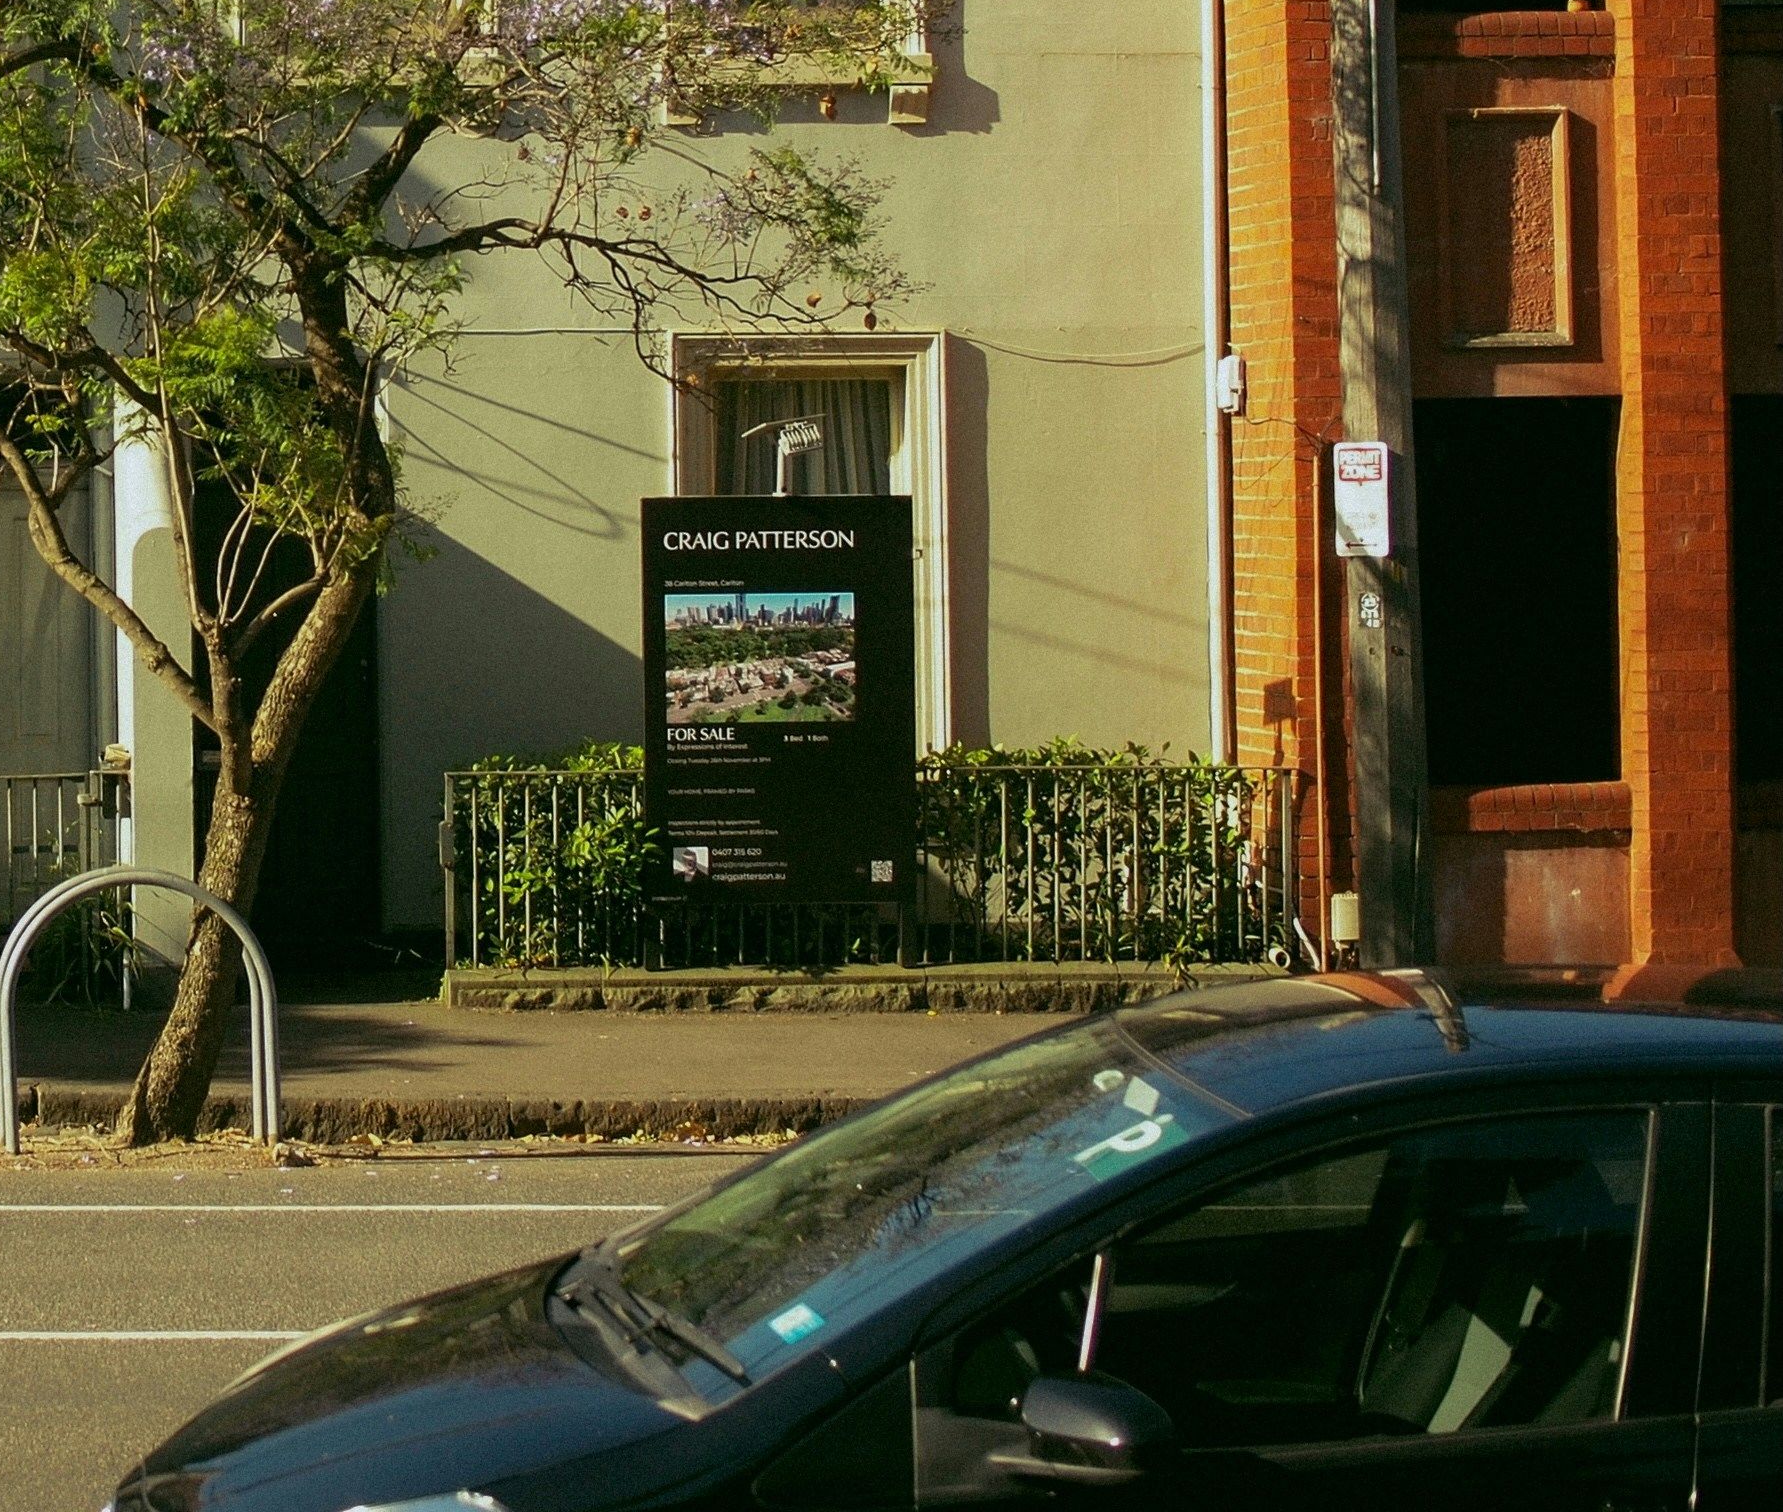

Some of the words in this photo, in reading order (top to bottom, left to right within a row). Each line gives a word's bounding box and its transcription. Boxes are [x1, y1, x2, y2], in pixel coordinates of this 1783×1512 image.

[1339, 451, 1381, 465] PERMIT
[1340, 465, 1381, 480] ZONE
[663, 531, 730, 551] CRAIG
[735, 529, 855, 550] PATTERSON
[720, 578, 745, 587] Carlton
[667, 728, 698, 742] FOR
[700, 727, 735, 741] SALE
[789, 734, 804, 743] Bed
[813, 734, 829, 742] Bath
[666, 743, 676, 752] By
[715, 742, 723, 751] of
[711, 847, 733, 856] 0407
[746, 847, 763, 856] 620
[712, 873, 787, 883] craigpatterson.au
[1073, 1119, 1163, 1164] P
